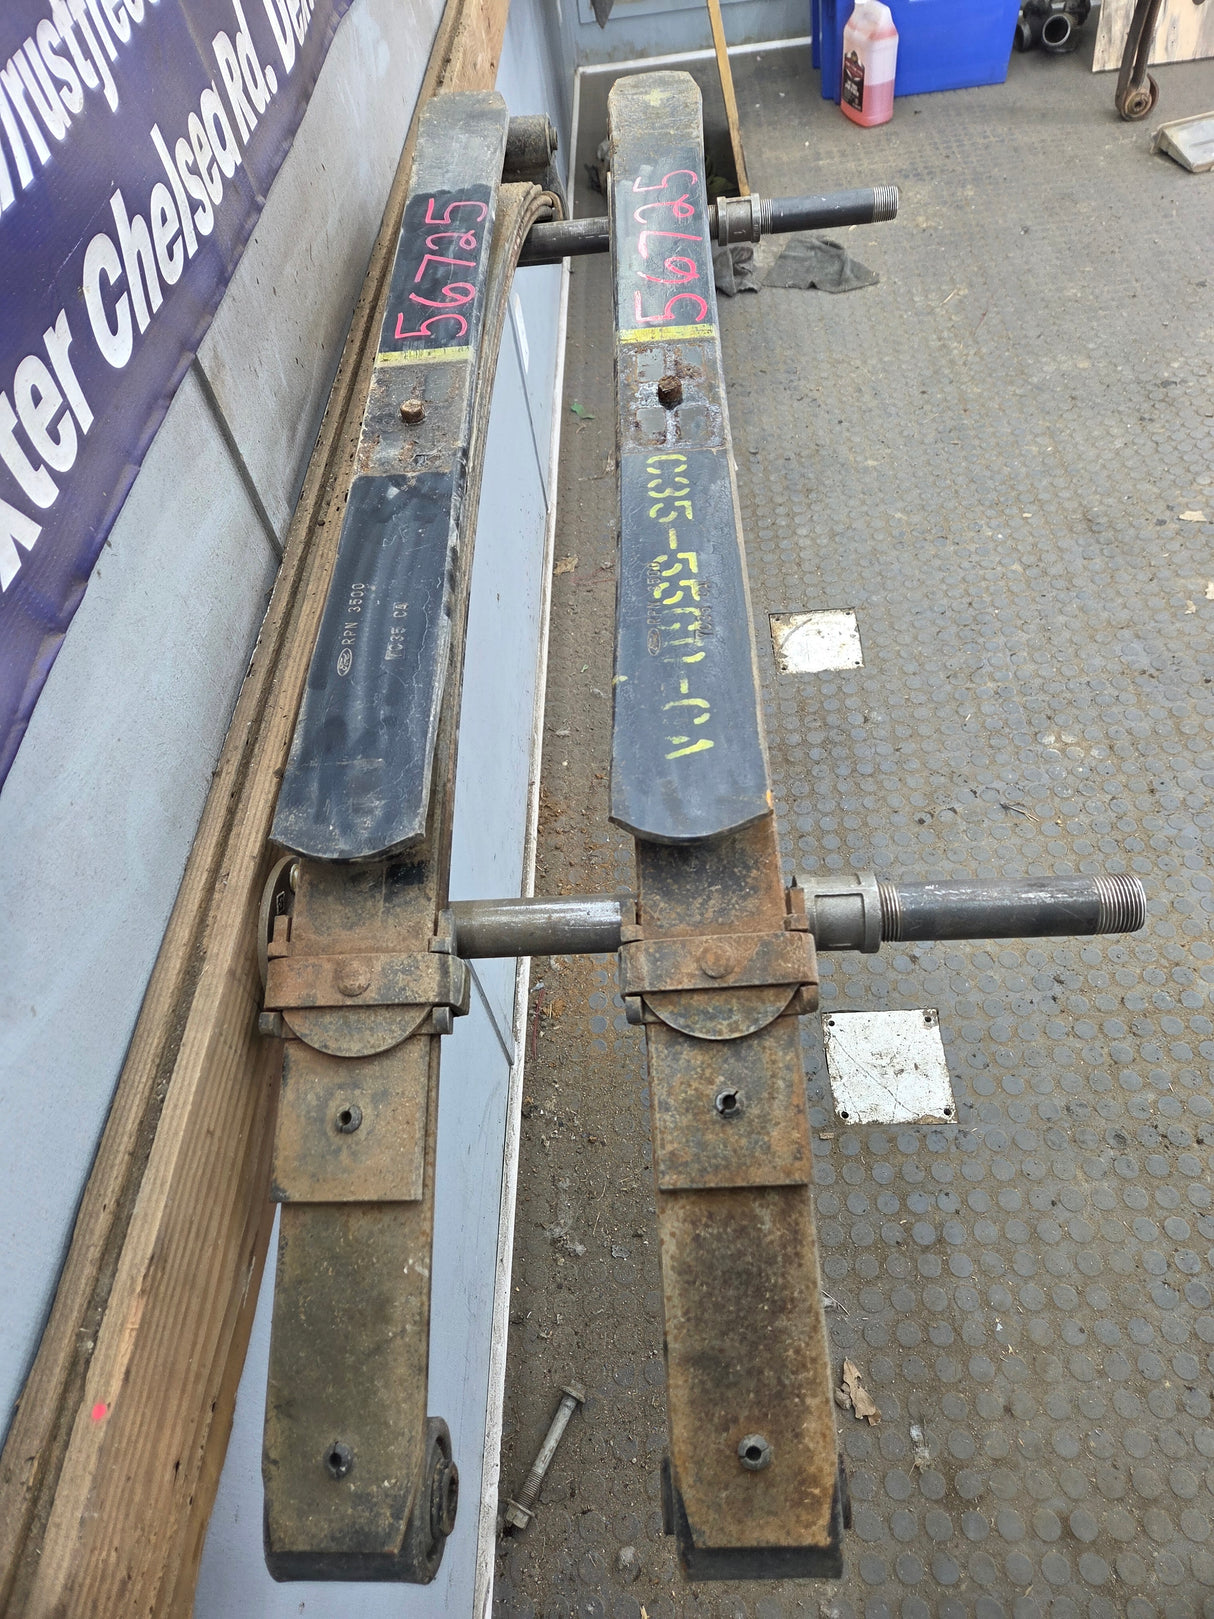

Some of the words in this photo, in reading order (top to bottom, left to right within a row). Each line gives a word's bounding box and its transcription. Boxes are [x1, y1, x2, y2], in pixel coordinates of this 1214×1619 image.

[82, 79, 242, 369] Chelsea
[211, 0, 278, 146] Rd.
[632, 169, 708, 324] 56725
[395, 197, 489, 339] 56725
[341, 621, 359, 645] RPN
[347, 582, 365, 613] 3500
